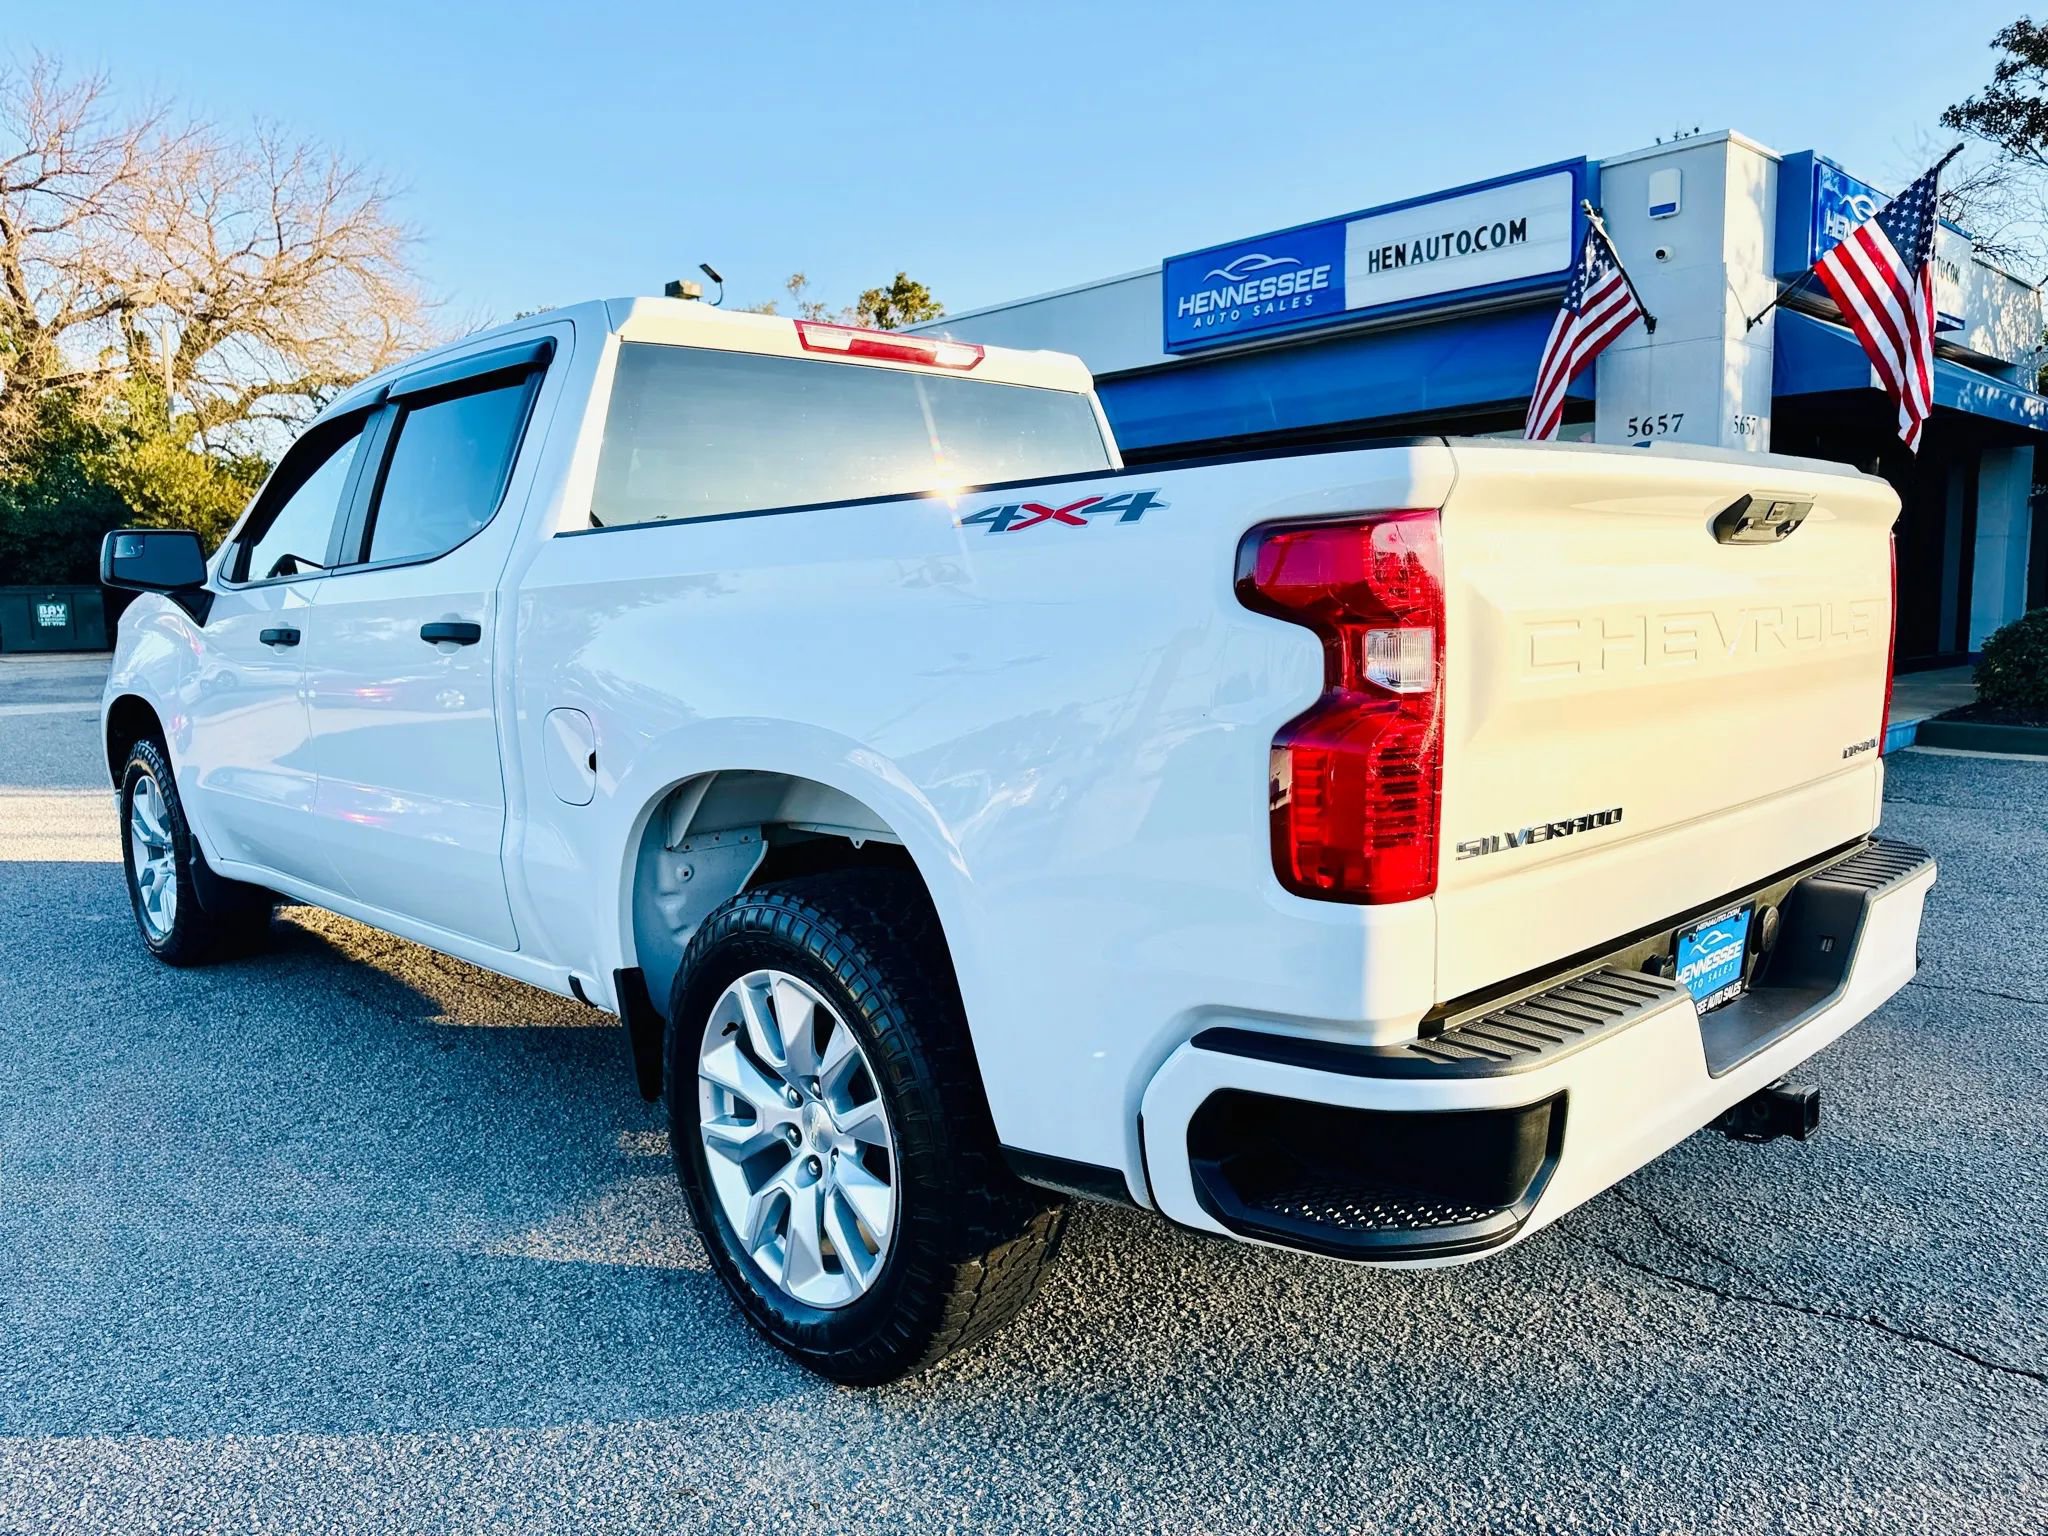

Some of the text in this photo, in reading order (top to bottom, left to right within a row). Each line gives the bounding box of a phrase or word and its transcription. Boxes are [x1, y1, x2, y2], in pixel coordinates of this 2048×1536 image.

[1368, 217, 1527, 273] HENAUTO.COM
[1178, 264, 1331, 318] HENNESSEE
[1193, 294, 1313, 329] AUTO SALES
[1627, 413, 1685, 437] 5657
[1733, 414, 1757, 435] 5657
[1520, 597, 1888, 683] CHEVROLE
[1456, 807, 1623, 861] SILVERADO
[1675, 938, 1745, 985] HENNESSEE
[1708, 961, 1734, 983] SALES
[1722, 980, 1743, 1002] SALES
